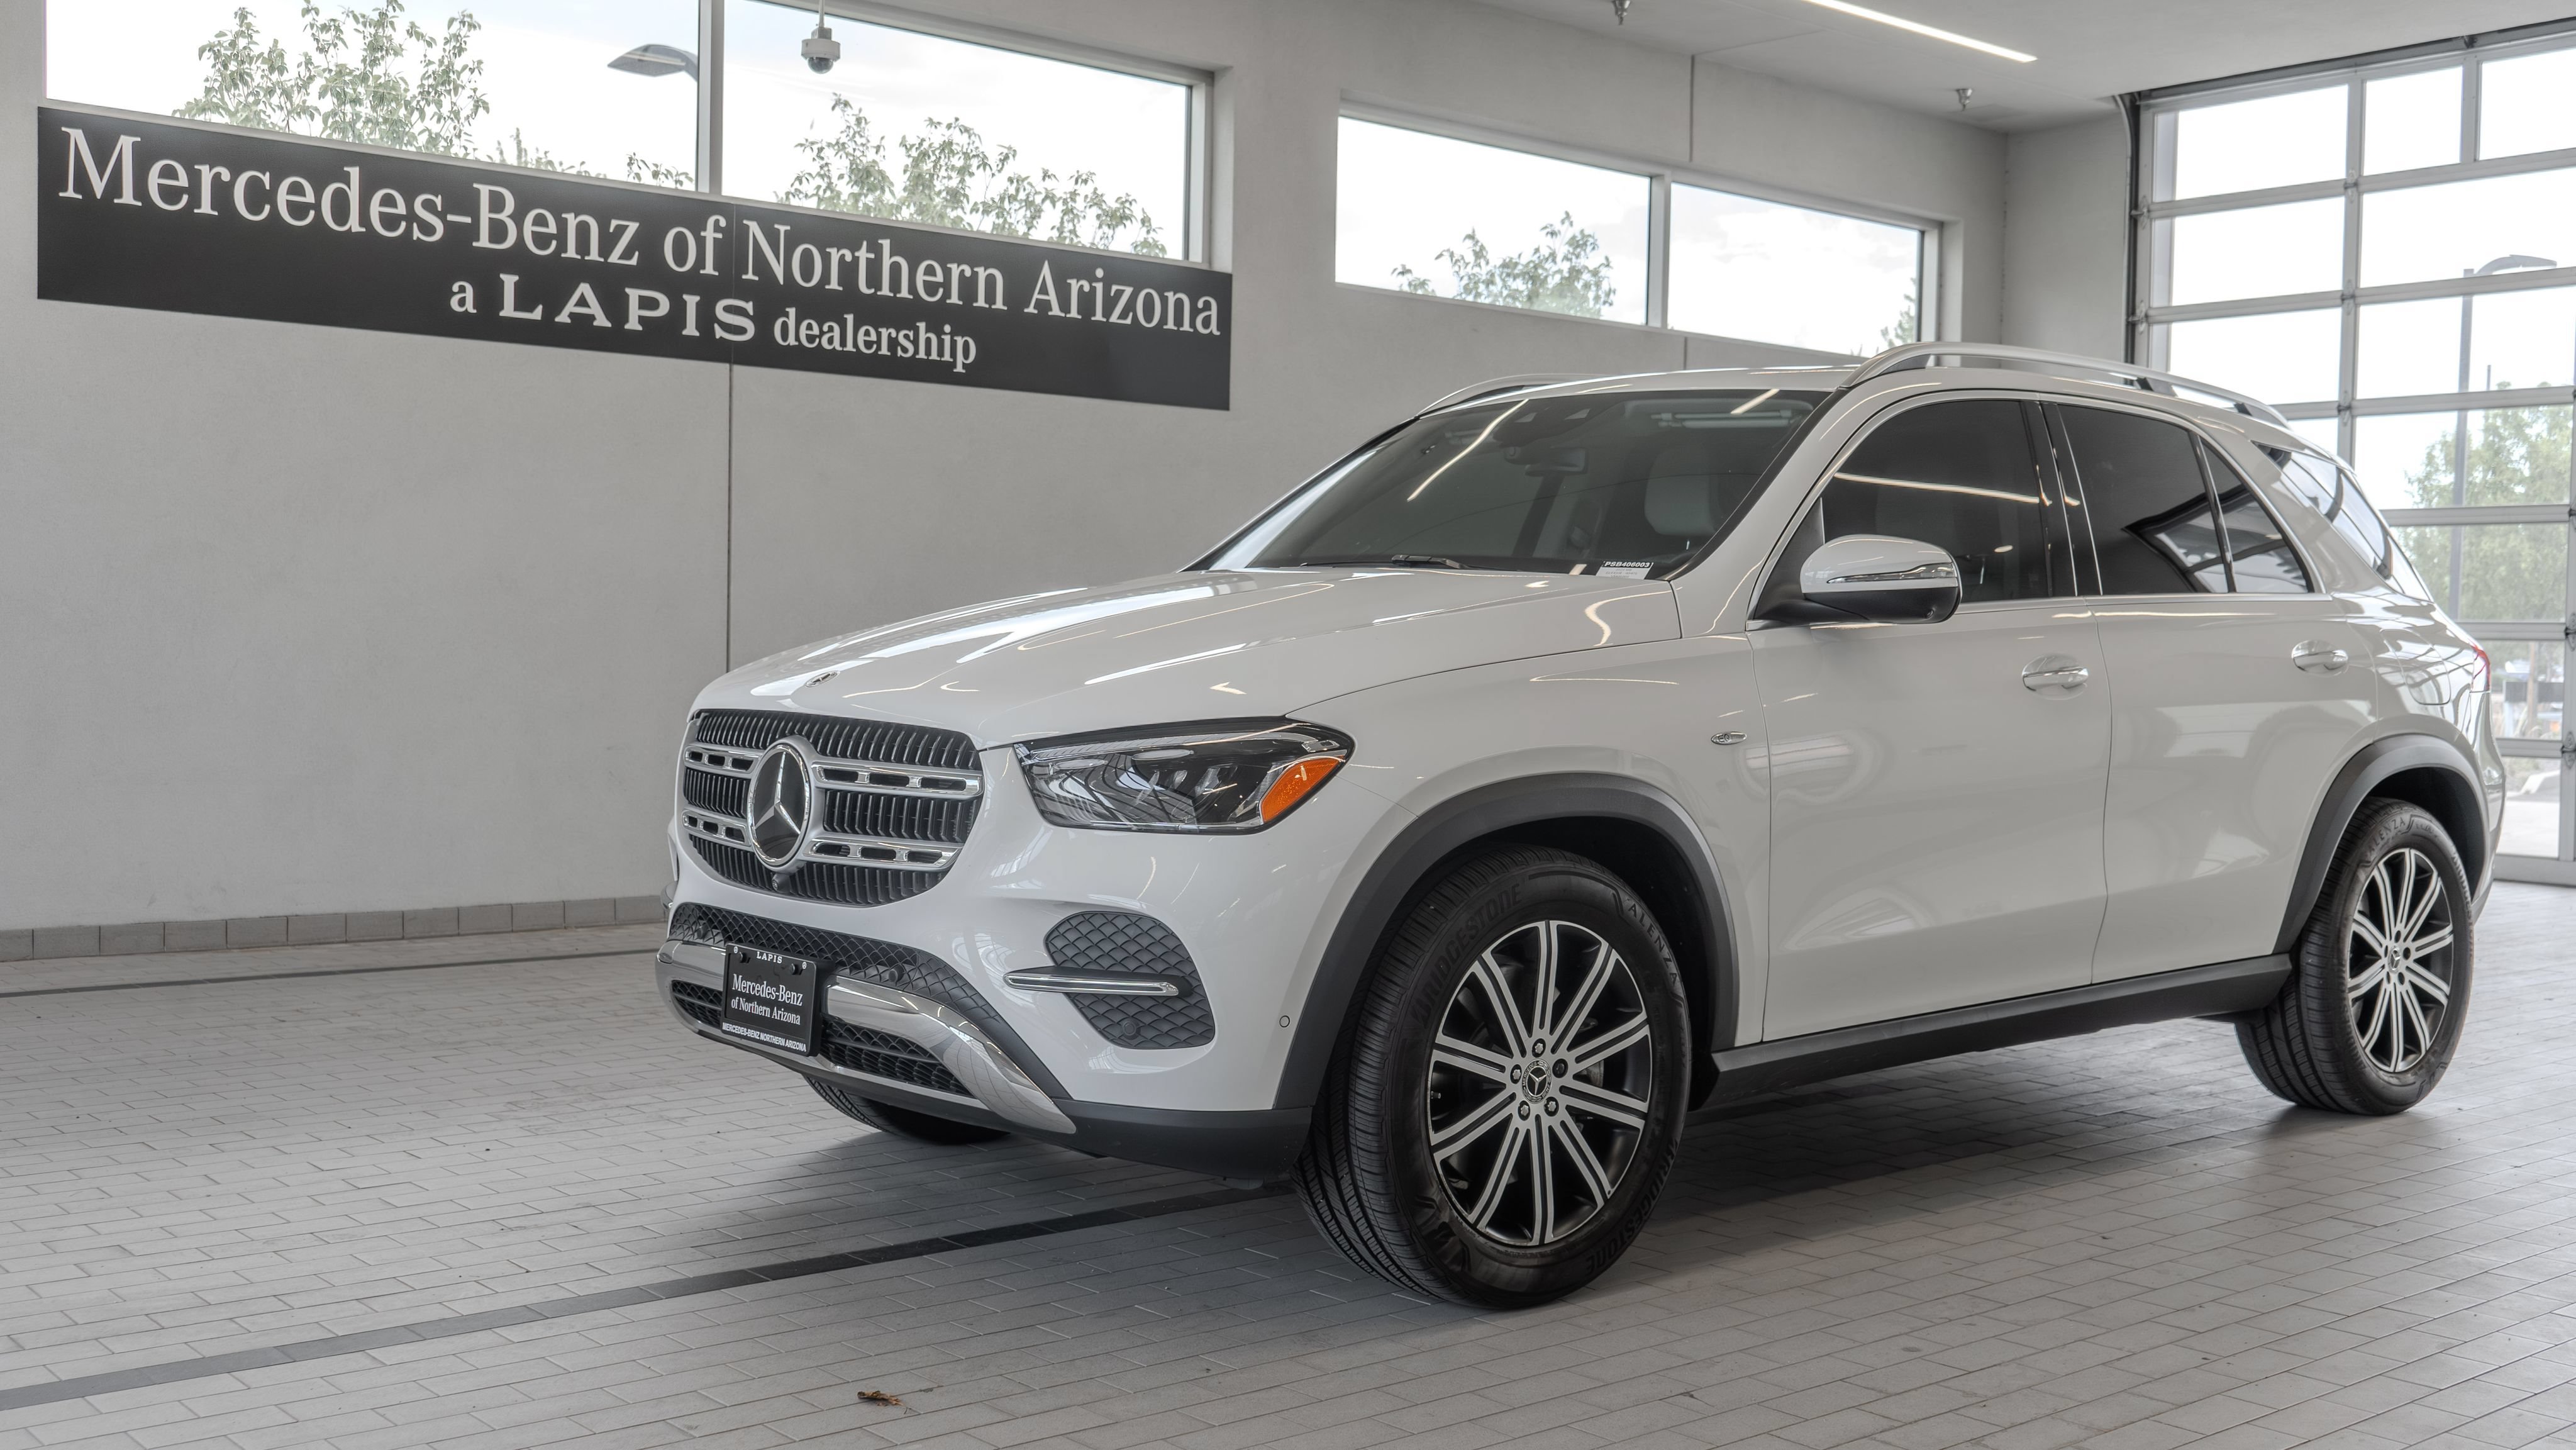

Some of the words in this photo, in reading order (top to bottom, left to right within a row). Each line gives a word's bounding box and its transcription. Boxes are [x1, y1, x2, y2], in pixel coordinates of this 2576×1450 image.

[58, 126, 640, 266] Mercedes-Benz
[663, 214, 727, 276] of
[741, 219, 1008, 310] Northern
[1023, 259, 1221, 335] Arizona
[450, 281, 477, 313] a
[499, 273, 755, 342] LAPIS
[774, 307, 977, 373] dealership
[757, 951, 782, 964] LAPIS
[732, 973, 803, 1007] Mercedes-Benz
[731, 996, 739, 1009] of
[739, 997, 771, 1018] Northern
[772, 1006, 801, 1025] Arizona
[722, 1022, 760, 1040] MERCEDES-BENZ
[760, 1032, 786, 1047] NORTHERN
[785, 1039, 806, 1052] ARIZONA
